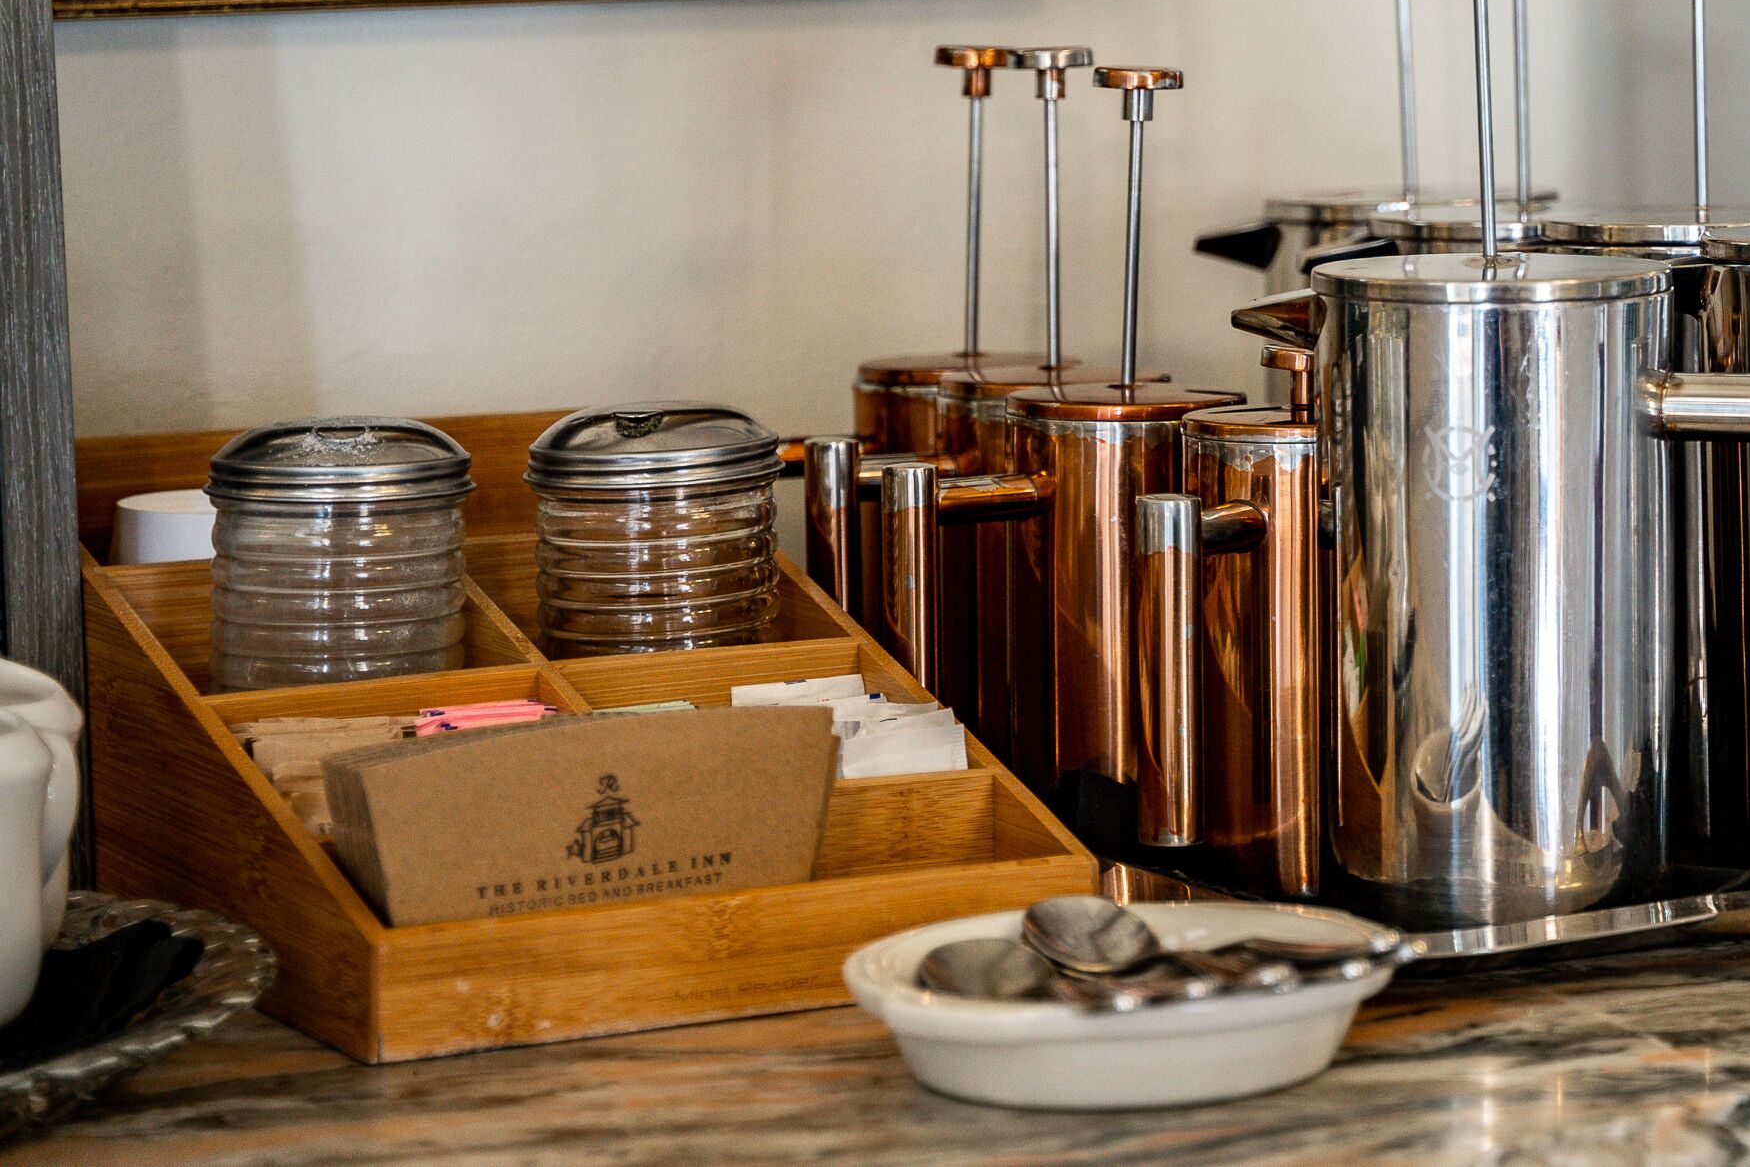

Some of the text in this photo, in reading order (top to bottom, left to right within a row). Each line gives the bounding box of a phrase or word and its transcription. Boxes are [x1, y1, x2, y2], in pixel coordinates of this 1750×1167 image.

[476, 852, 732, 900] THE RIVERDALE INN
[488, 872, 722, 915] HISTORIC BED AND BREAKFAST
